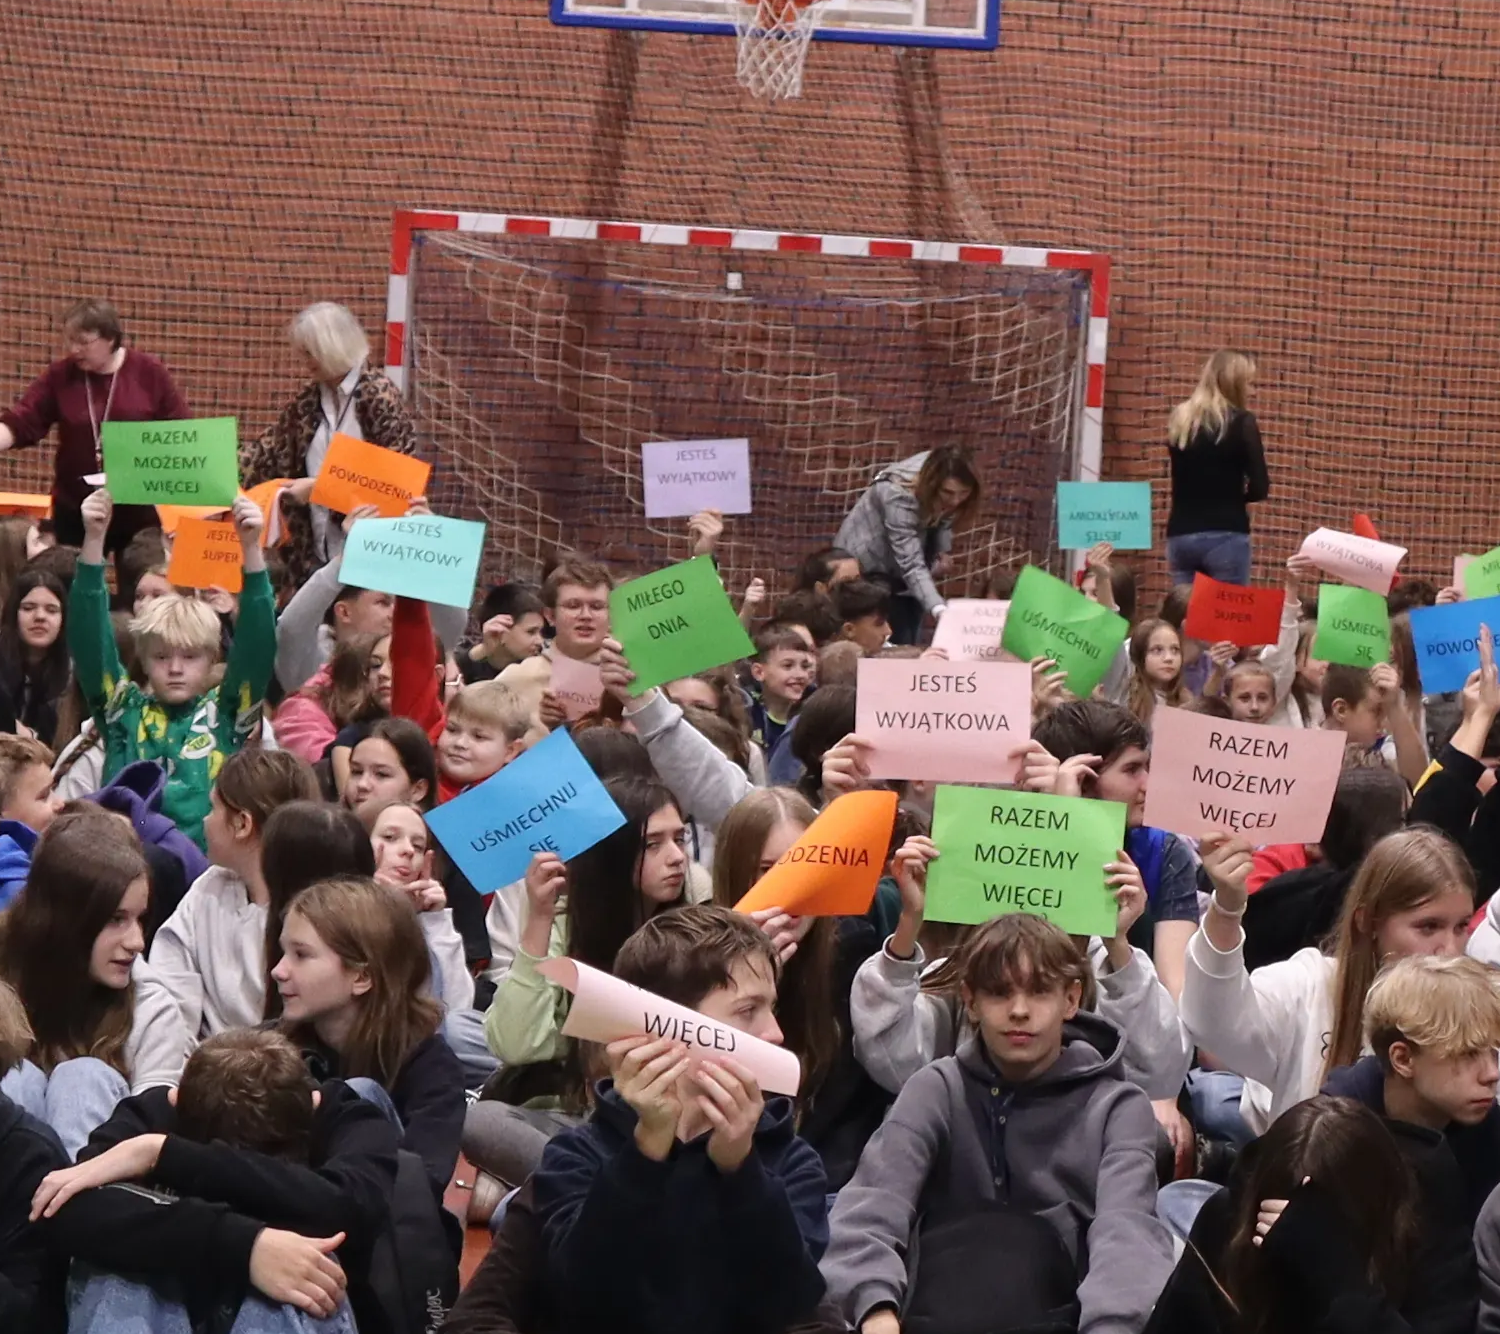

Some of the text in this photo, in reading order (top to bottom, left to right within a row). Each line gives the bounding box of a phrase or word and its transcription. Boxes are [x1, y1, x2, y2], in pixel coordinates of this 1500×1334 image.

[141, 428, 198, 445] RAZEM
[133, 452, 208, 470] MOŻEMY
[676, 447, 717, 463] JESTEŚ
[143, 478, 201, 496] WIĘCEJ
[328, 465, 414, 501] POWODZENIA
[656, 470, 737, 486] WYJĄTKOWY
[392, 519, 443, 539] JESTEŚ
[362, 540, 464, 570] WYJĄTKOWY
[1315, 539, 1385, 575] WYJĄTKOWA
[626, 578, 685, 613] MIŁEGO
[972, 606, 1007, 619] RAZE
[647, 614, 690, 641] DNIA
[961, 624, 1003, 637] MOŻEM
[1021, 609, 1103, 661] UŚMIECHNIJ
[961, 644, 1002, 659] WIĘCE
[1355, 645, 1374, 662] SIĘ
[909, 671, 978, 693] JESTEŚ
[876, 710, 1010, 734] WYJĄTKOWA
[1209, 731, 1289, 760] RAZEM
[1192, 766, 1297, 797] MOŻEMY
[470, 781, 578, 854] UŚMIECHNIJ
[991, 805, 1070, 832] RAZEM
[1199, 801, 1278, 834] WIĘCEJ
[778, 844, 870, 868] ODZENIA
[974, 842, 1080, 872] MOŻEMY
[982, 882, 1063, 912] WIĘCEJ
[643, 1011, 737, 1054] WIĘCEJ
